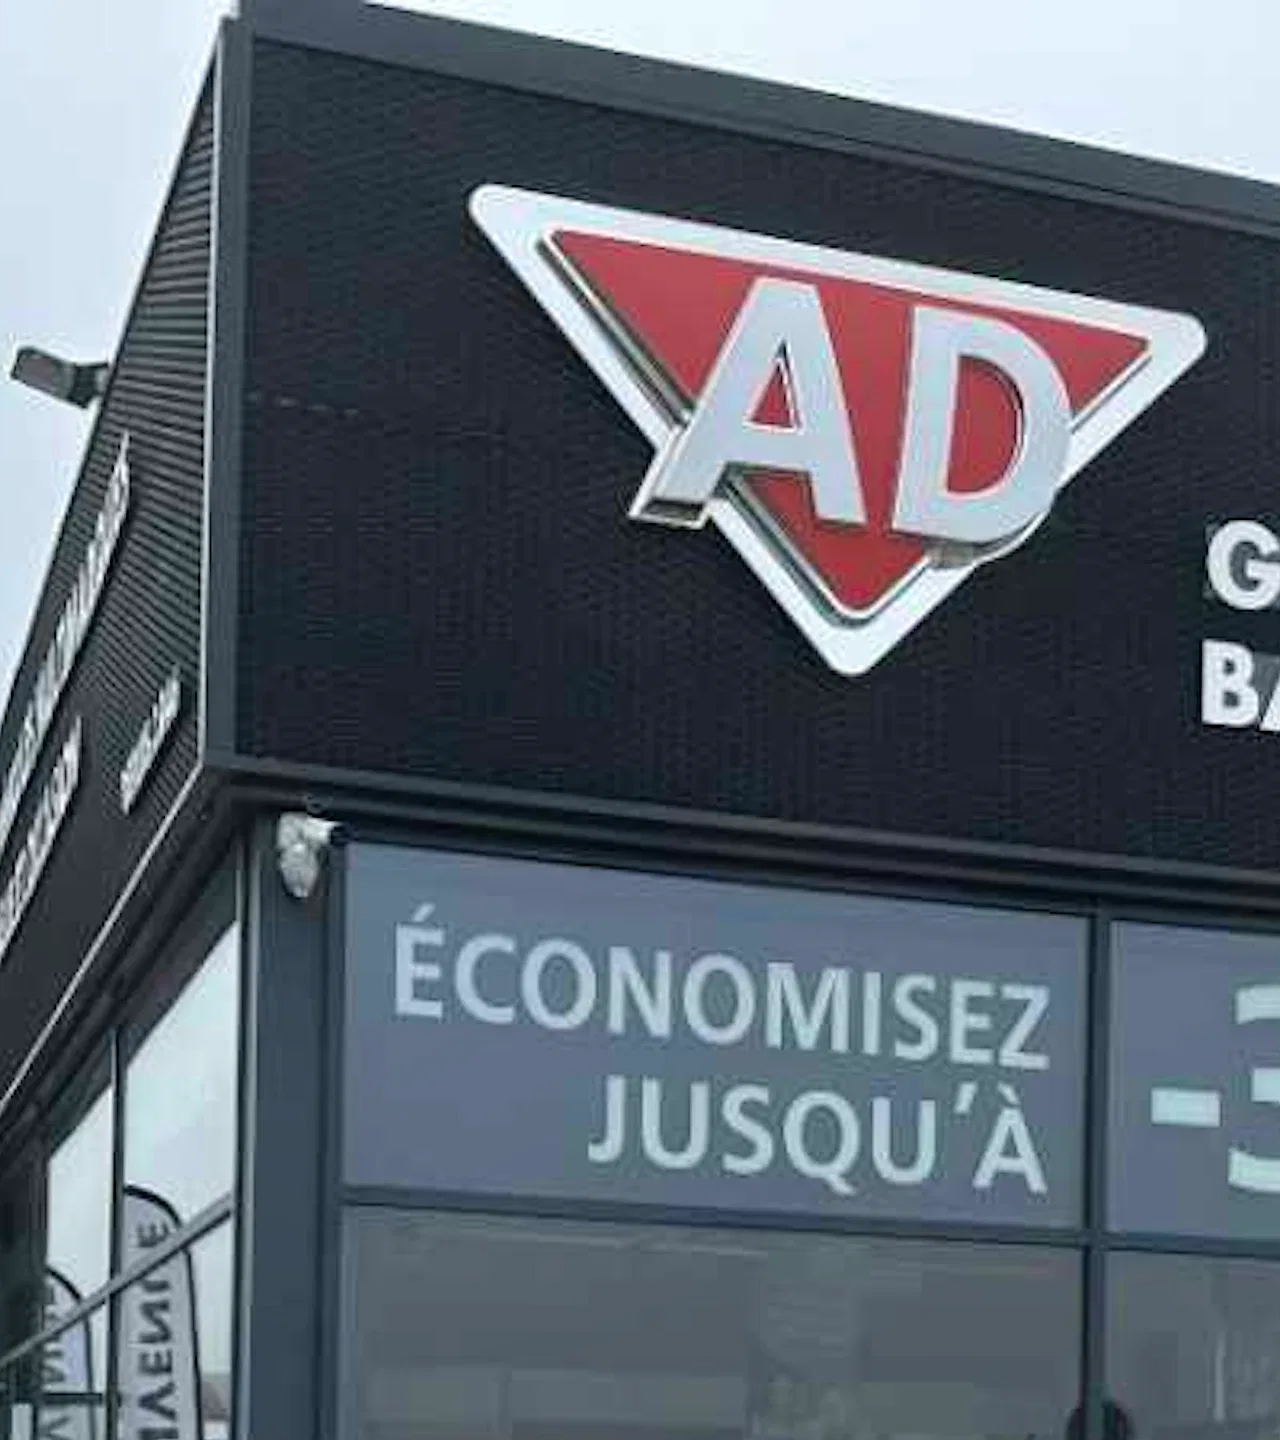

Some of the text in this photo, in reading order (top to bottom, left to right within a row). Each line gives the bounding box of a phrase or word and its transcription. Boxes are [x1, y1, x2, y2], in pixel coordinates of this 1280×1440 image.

[645, 276, 1074, 550] AD
[394, 903, 1050, 1071] ÉCONOMISEZ
[587, 1075, 1048, 1196] JUSQU'À
